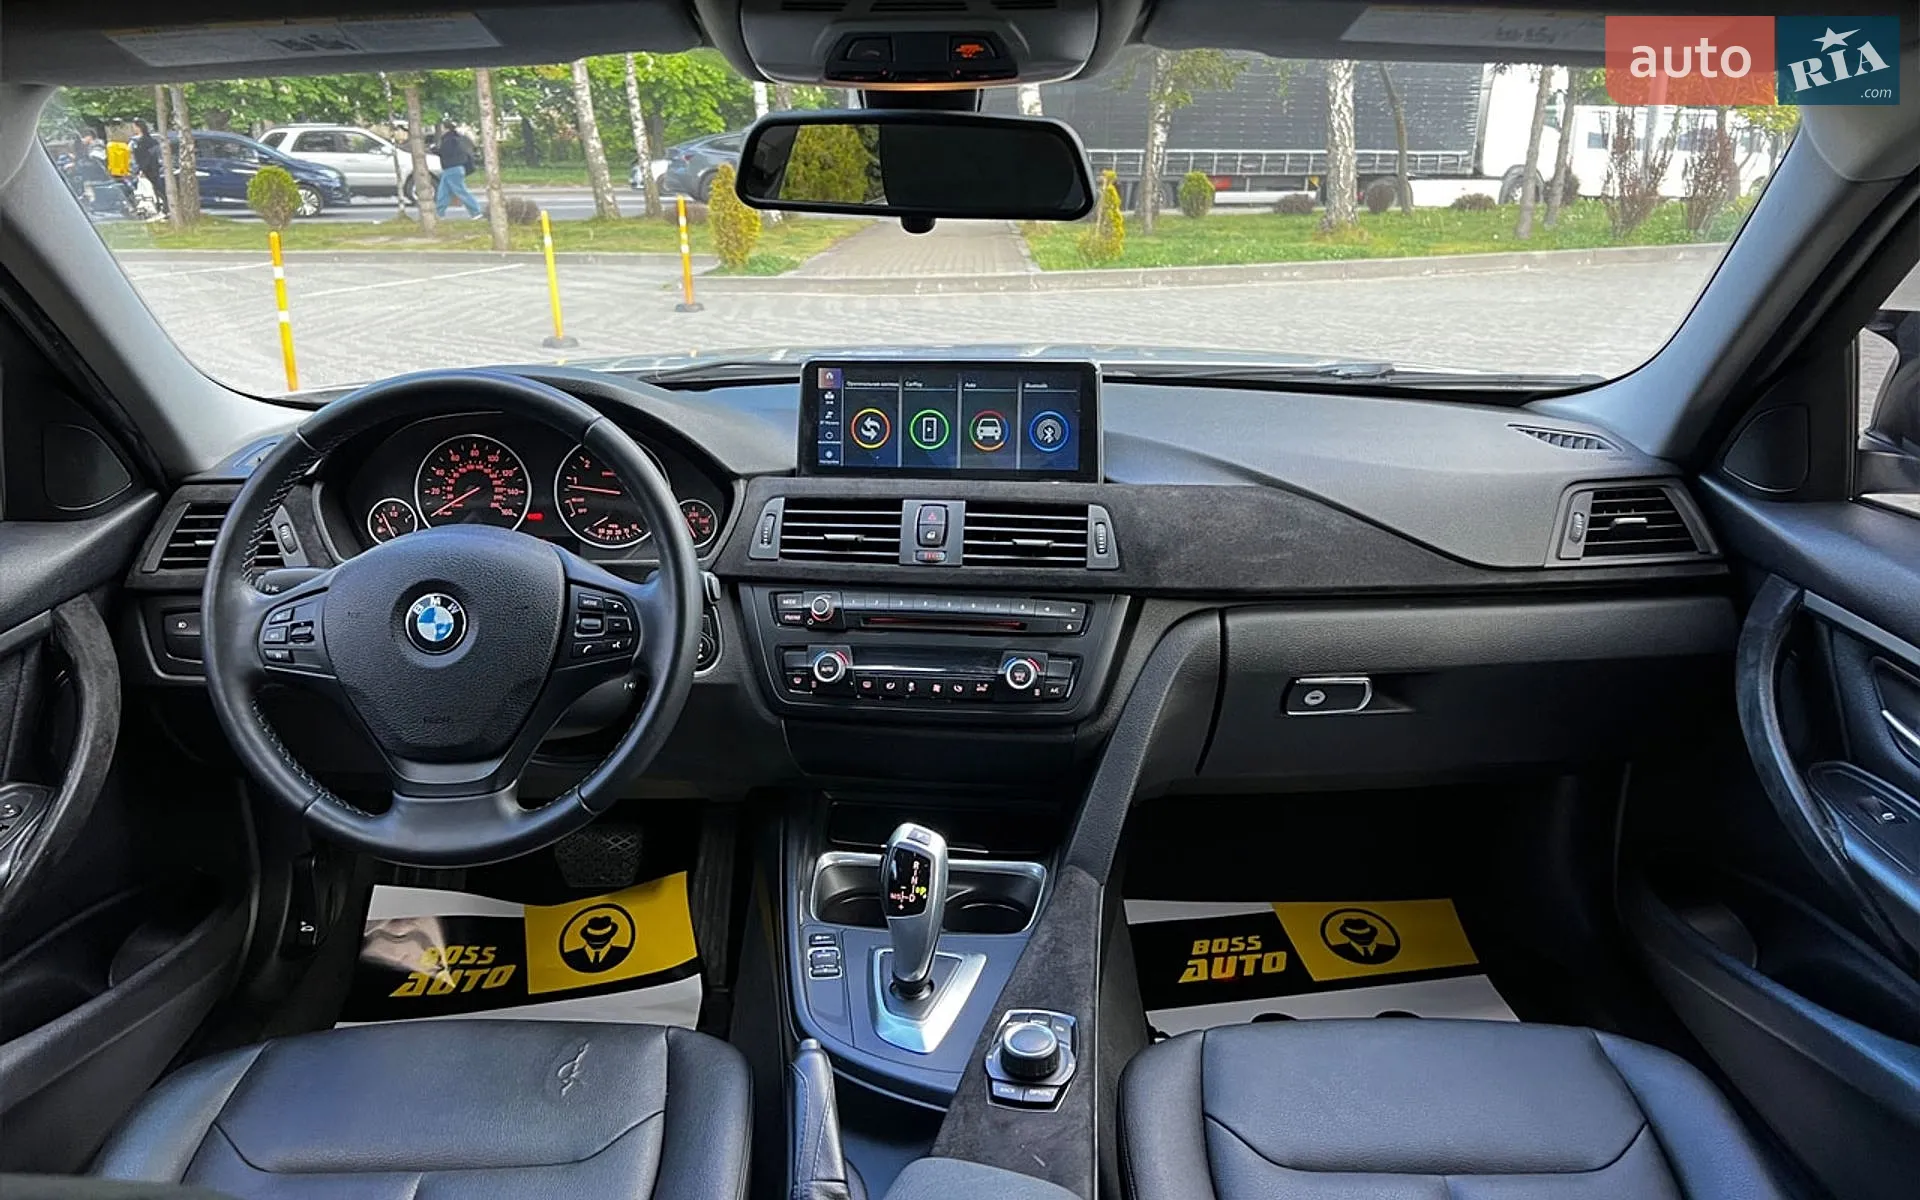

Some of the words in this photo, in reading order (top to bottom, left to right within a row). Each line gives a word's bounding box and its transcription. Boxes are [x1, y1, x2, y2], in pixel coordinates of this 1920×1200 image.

[411, 596, 460, 615] BMW
[1191, 935, 1262, 955] BOSS
[1178, 951, 1287, 983] AUTO
[388, 964, 517, 997] AUTO
